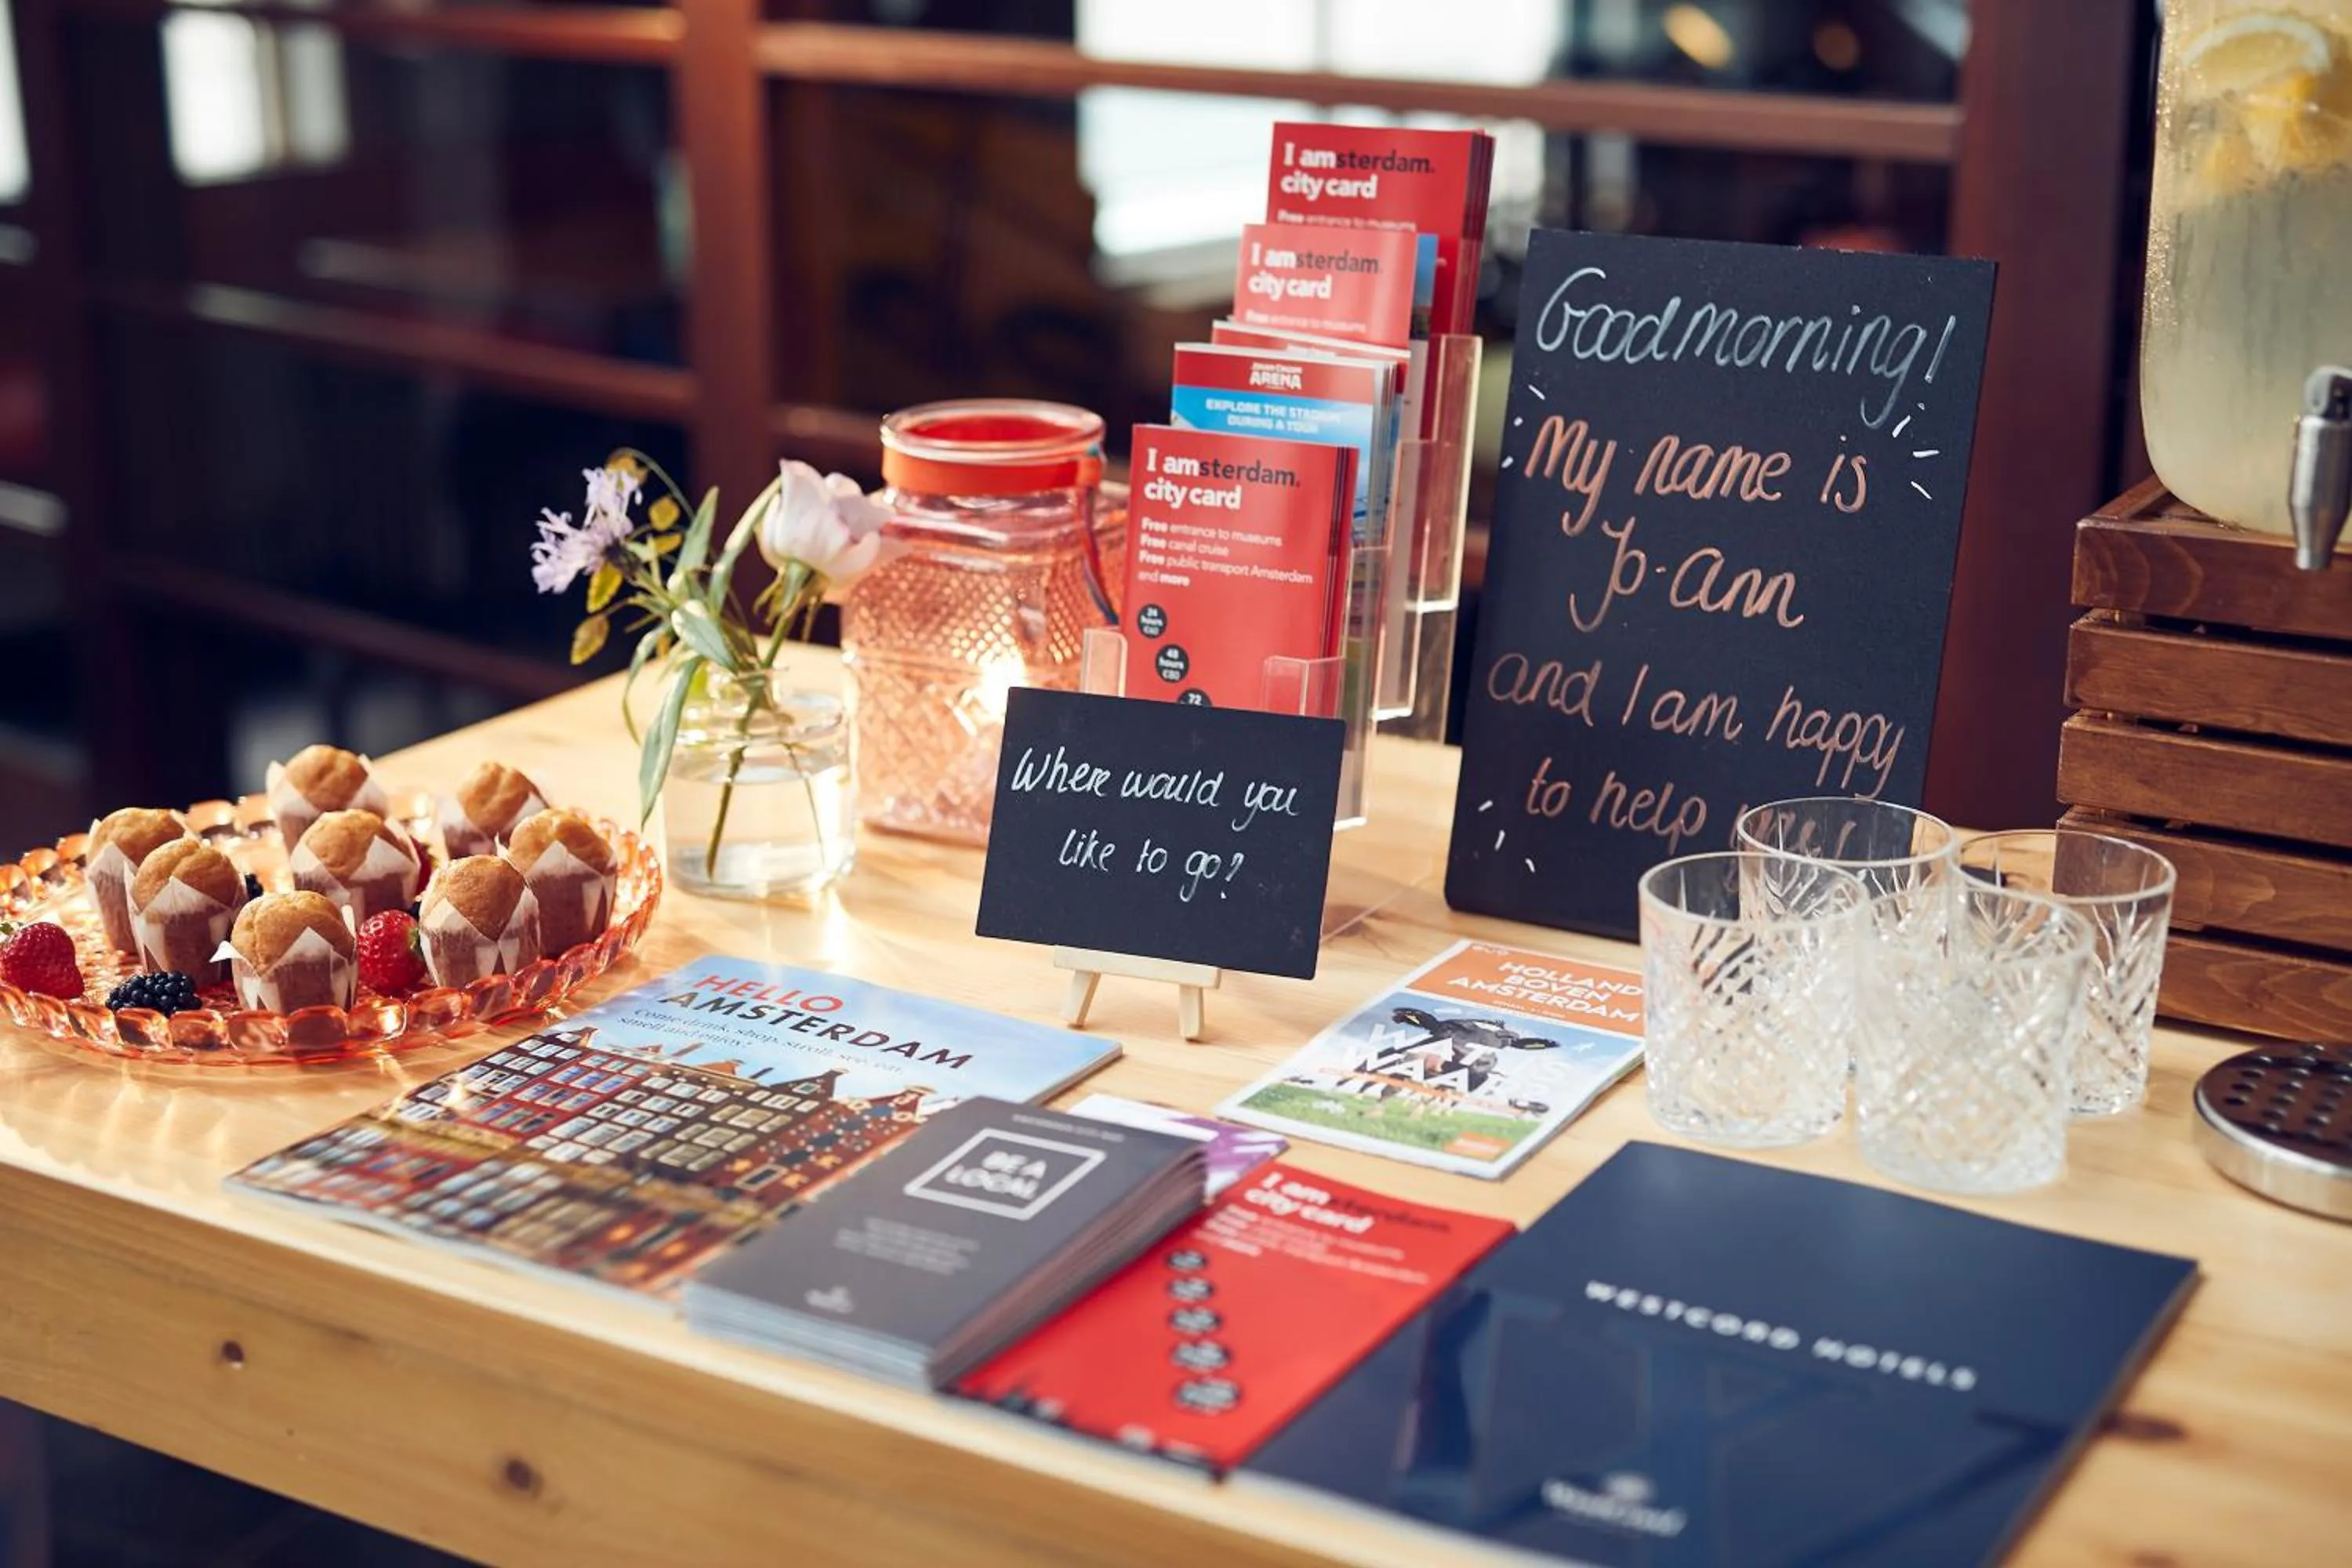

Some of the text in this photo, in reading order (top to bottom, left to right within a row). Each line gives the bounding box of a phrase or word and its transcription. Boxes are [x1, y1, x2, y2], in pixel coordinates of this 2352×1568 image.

[1283, 141, 1295, 166] I
[1280, 169, 1378, 201] city card
[1251, 241, 1261, 267] I
[1248, 270, 1332, 302] city card
[1249, 372, 1302, 390] ARENA
[1262, 403, 1287, 418] THE
[1275, 419, 1285, 431] A
[1146, 447, 1159, 472] I
[1635, 434, 1791, 503] name
[1819, 434, 1867, 514] is
[1144, 476, 1243, 510] city card
[1140, 533, 1230, 557] Free canal cruise
[1142, 516, 1283, 547] Free entrance to museums
[1138, 550, 1313, 585] Free public transport Amsterdam
[1138, 569, 1191, 587] and more
[1188, 692, 1203, 706] 72
[1487, 652, 1602, 727] and
[1650, 688, 1744, 741] am
[1766, 684, 1906, 800] happy
[1011, 746, 1301, 833] Where would you
[1525, 756, 1571, 818] to
[1590, 770, 1708, 855] help
[1135, 838, 1168, 874] to
[1179, 849, 1245, 903] go?
[692, 975, 844, 1013] HELLO
[1497, 960, 1645, 996] HOLLAND
[1504, 975, 1612, 1004] BOVEN
[1446, 976, 1641, 1023] AMSTERDAM
[658, 991, 974, 1071] AMSTERDAM
[1298, 1203, 1375, 1235] card
